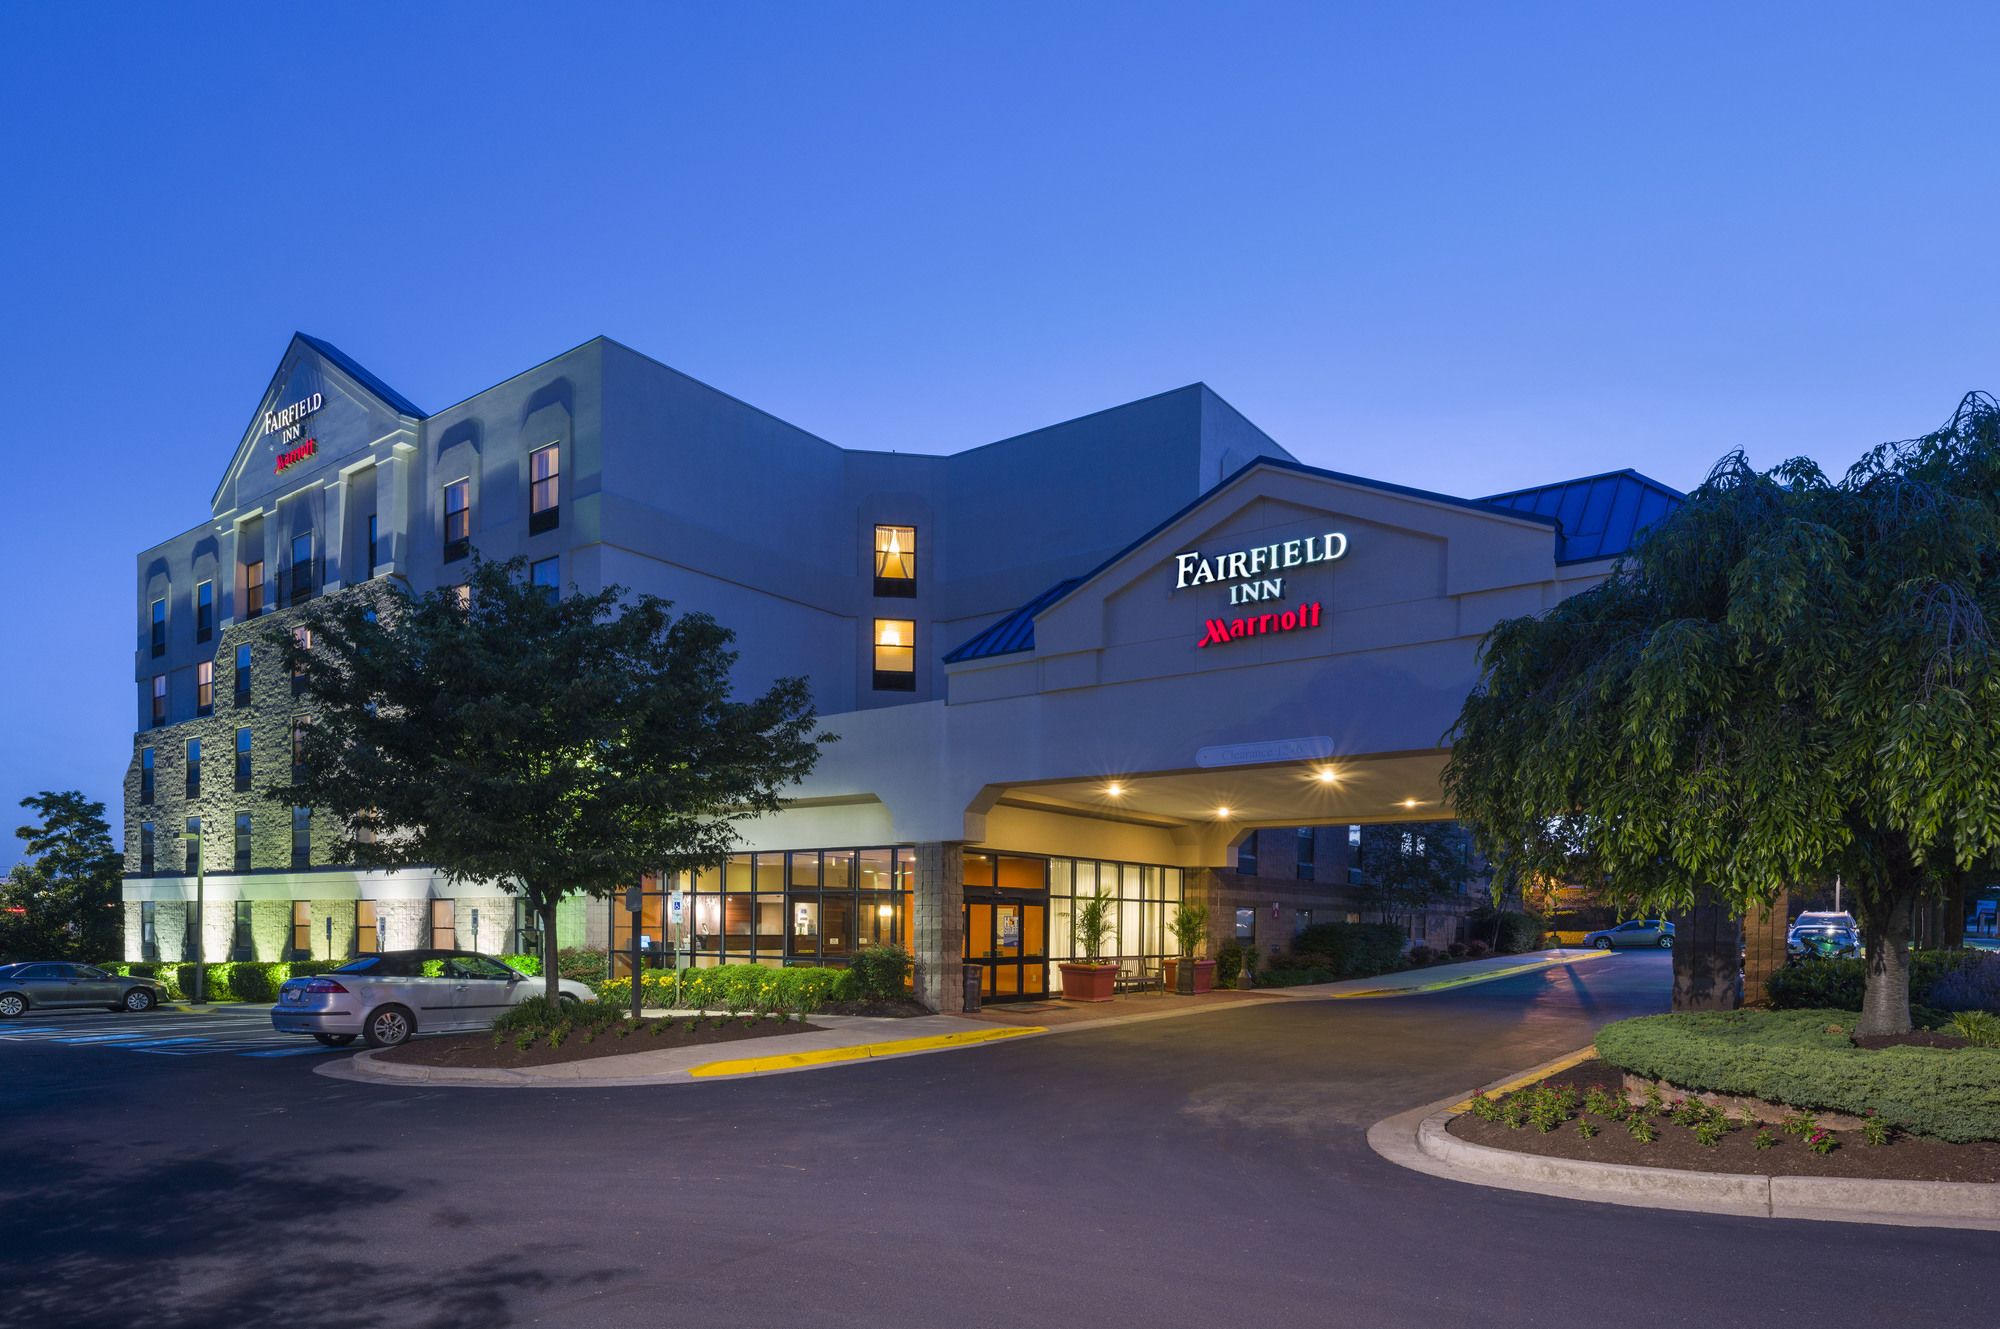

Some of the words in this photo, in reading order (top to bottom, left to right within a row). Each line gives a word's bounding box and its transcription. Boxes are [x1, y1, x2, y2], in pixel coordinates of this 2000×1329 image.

[265, 392, 322, 435] FAIRFIELD
[282, 424, 300, 444] INN
[1176, 532, 1348, 588] FAIRFIELD
[1229, 577, 1283, 605] INN
[1197, 601, 1322, 648] Marriott
